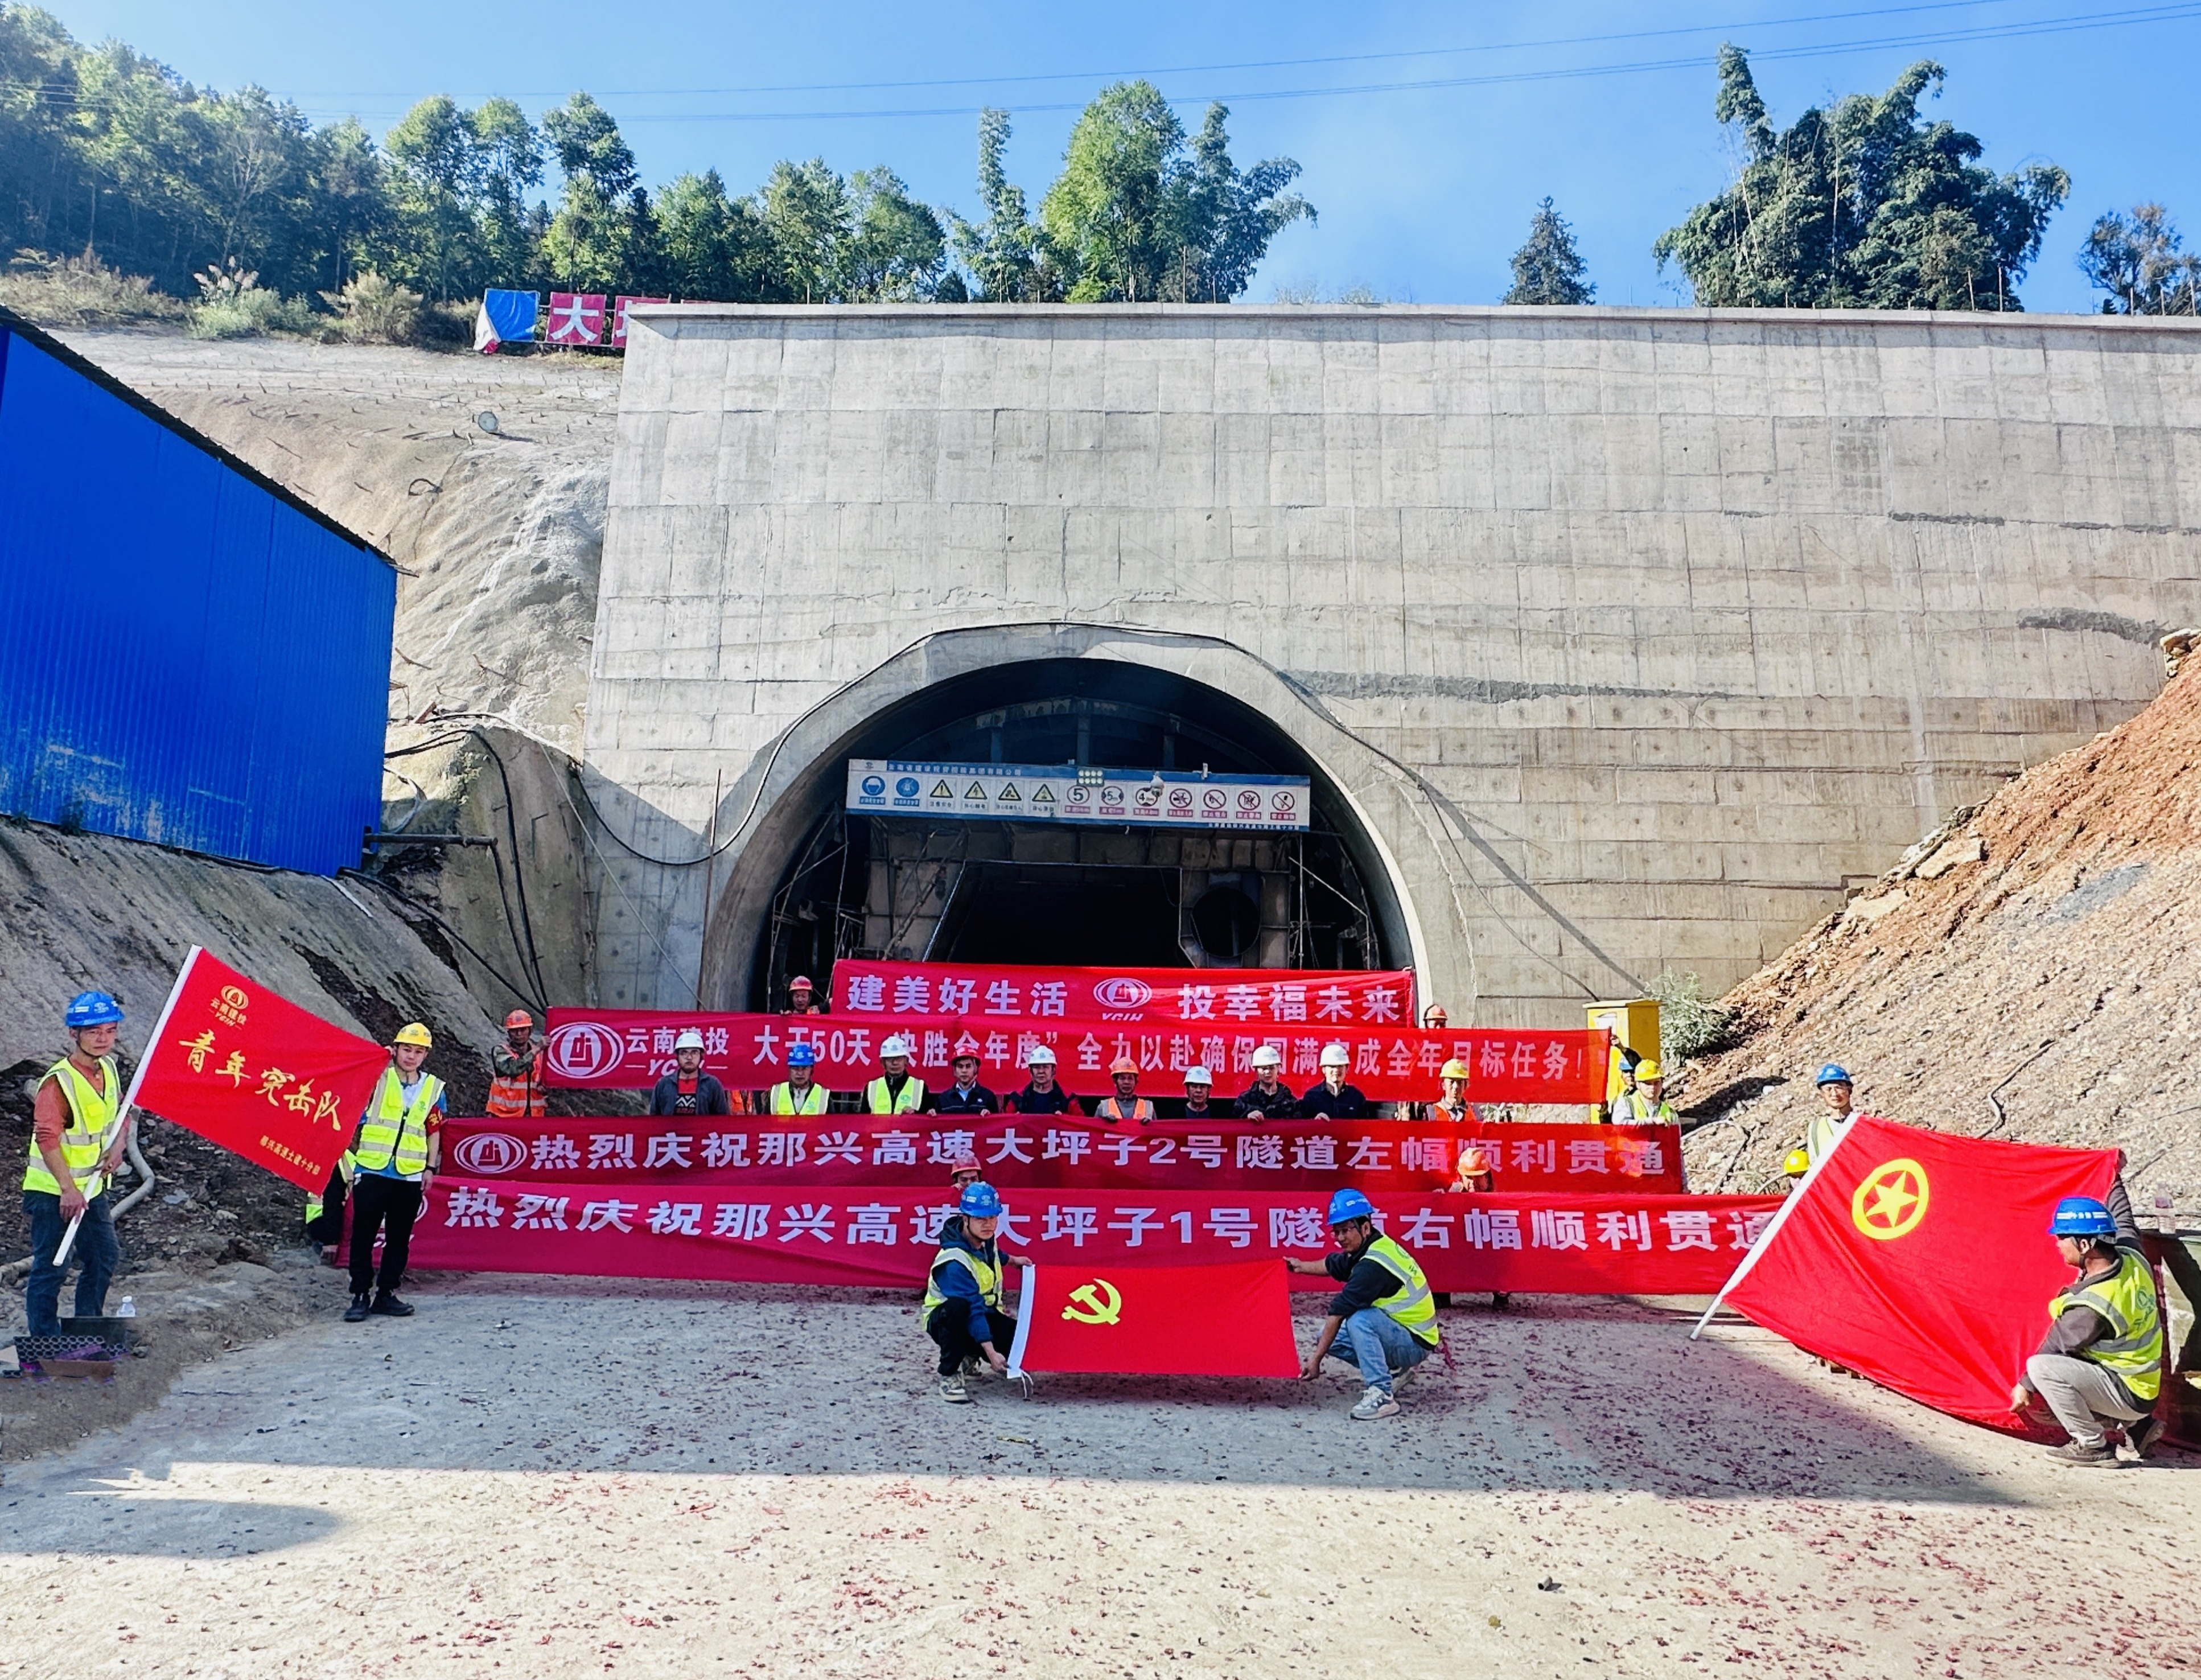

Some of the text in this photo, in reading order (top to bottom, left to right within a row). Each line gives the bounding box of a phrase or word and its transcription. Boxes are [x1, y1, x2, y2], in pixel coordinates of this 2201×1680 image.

[1073, 788, 1084, 801] 5
[846, 974, 1399, 1023] 建美好生活 投幸福未来
[626, 1026, 729, 1056] 云南投
[178, 1029, 342, 1131] 青年突击队
[445, 1187, 1778, 1252] 热烈庆祝那兴高速大坪子1号隧右幅顺利贯通
